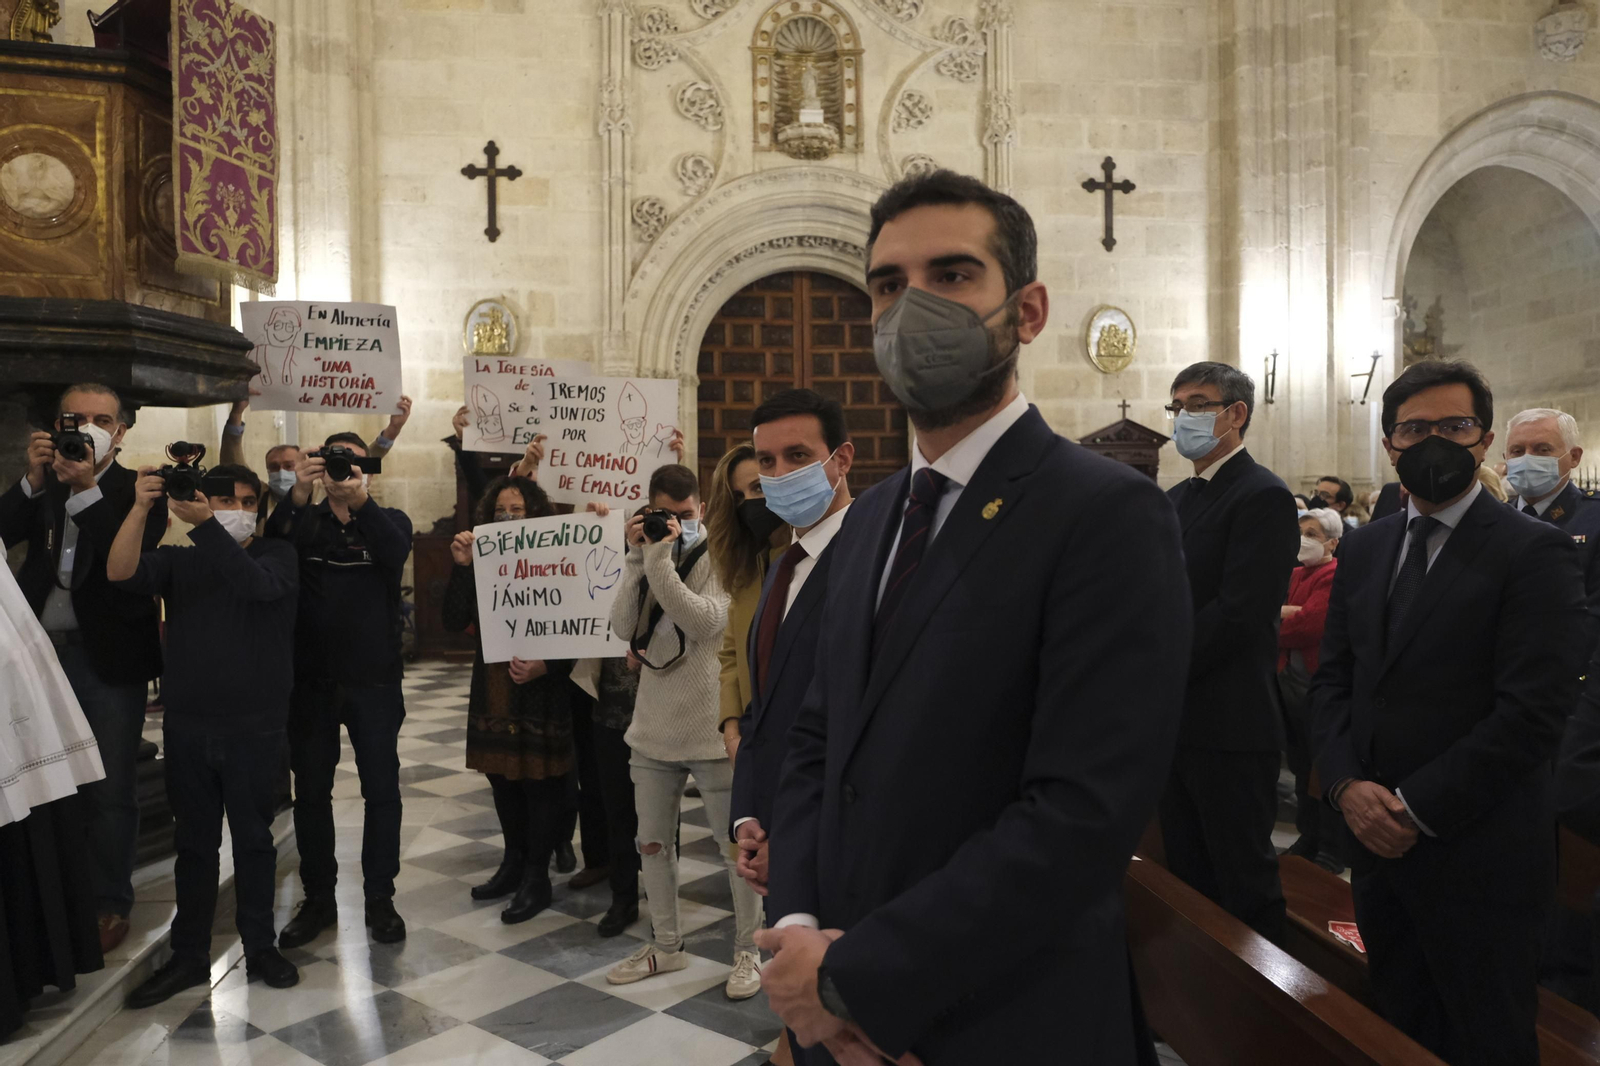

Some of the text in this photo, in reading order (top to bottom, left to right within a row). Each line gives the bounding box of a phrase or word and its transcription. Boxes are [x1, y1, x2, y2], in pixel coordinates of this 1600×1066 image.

[331, 308, 391, 328] Almería
[475, 359, 491, 373] LA
[514, 378, 530, 390] de
[547, 382, 606, 403] IREMOS
[298, 392, 314, 404] de
[549, 406, 605, 422] JUNTOS
[562, 428, 587, 442] POR
[549, 449, 569, 467] EL
[558, 474, 641, 501] DE EMAÚS
[498, 557, 578, 580] a Almería
[505, 617, 612, 642] Y ADELANTE!
